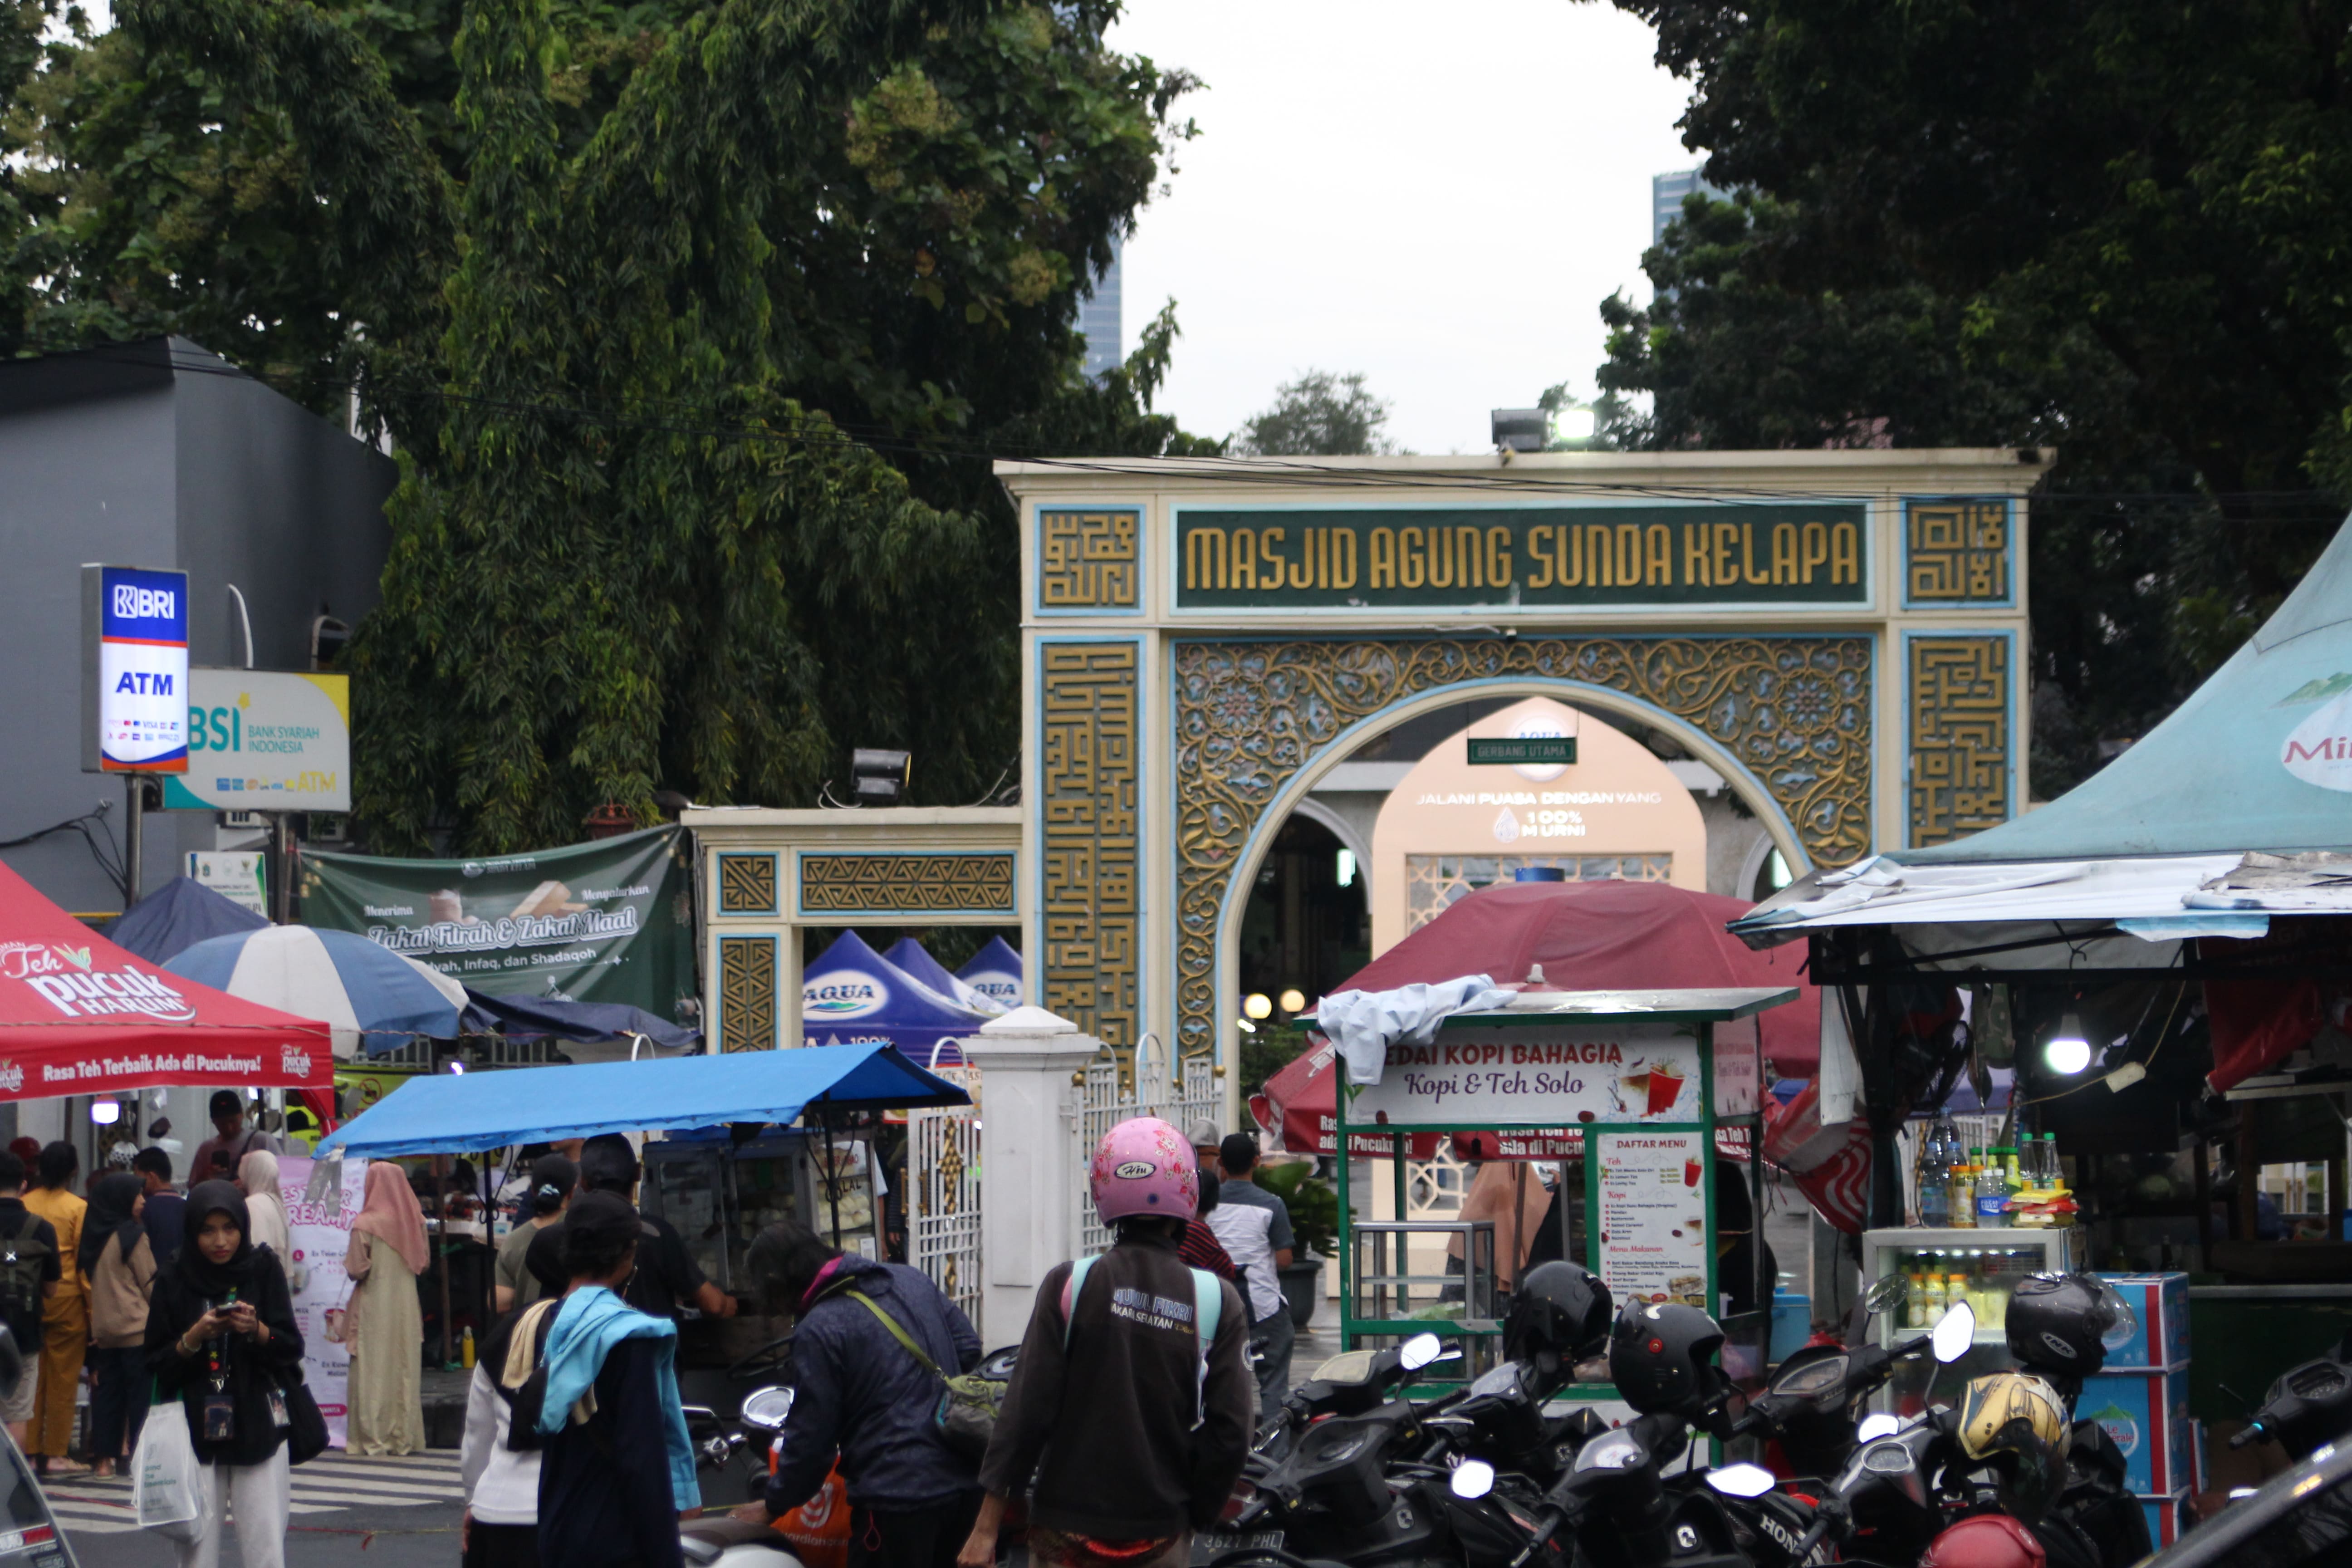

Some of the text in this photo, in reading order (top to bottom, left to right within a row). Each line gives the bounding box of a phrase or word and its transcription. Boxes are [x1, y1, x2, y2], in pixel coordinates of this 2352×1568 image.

[1186, 527, 1357, 589] MASJID
[1369, 526, 1513, 589] AGUNG
[1528, 524, 1673, 588] SUNDA
[1684, 522, 1859, 588] KELAPA
[138, 588, 175, 620] BRI
[116, 672, 173, 696] ATM
[189, 706, 241, 752] BSI
[248, 725, 320, 740] BANK SYARIAH
[248, 741, 304, 753] INDONESIA
[1477, 745, 1567, 757] GERBANG UTAMA
[2283, 736, 2352, 764] Mi
[298, 771, 337, 793] ATM
[1416, 792, 1662, 805] JALANI PUASA DENGAN YANG
[1528, 811, 1583, 824] 100%
[581, 885, 650, 902] Menyalurkan
[364, 904, 414, 917] Menerima
[434, 922, 495, 949] Fitrah
[498, 920, 515, 945] &
[517, 915, 577, 939] Zakat
[581, 907, 636, 936] Maal
[1, 943, 64, 979] Teh
[464, 959, 501, 970] Infaq,
[504, 955, 528, 968] dan
[530, 947, 597, 965] Shadaqoh
[24, 964, 185, 1018] pucuk
[803, 985, 875, 1001] AQUA
[974, 983, 1017, 997] QUA
[76, 997, 192, 1019] HARUM
[1385, 1042, 1623, 1066] EDAI KOPI BAHAGIA
[43, 1054, 262, 1082] Rasa Teh Terbaik Ada di Pucuknya!
[1404, 1070, 1585, 1099] Kopi & Teh Solo
[1727, 1127, 1744, 1143] Teh
[1499, 1138, 1585, 1155] ada di Pucu
[1617, 1140, 1687, 1149] DAFTAR MENU
[1607, 1157, 1622, 1166] Teh
[1607, 1191, 1627, 1201] Kopi
[1152, 1296, 1193, 1322] FIKRI
[1135, 1312, 1173, 1330] SELATAN
[2045, 1335, 2073, 1354] INK
[2107, 1424, 2118, 1434] Le
[2111, 1433, 2134, 1442] erale
[1205, 1534, 1278, 1548] 3627 PHL
